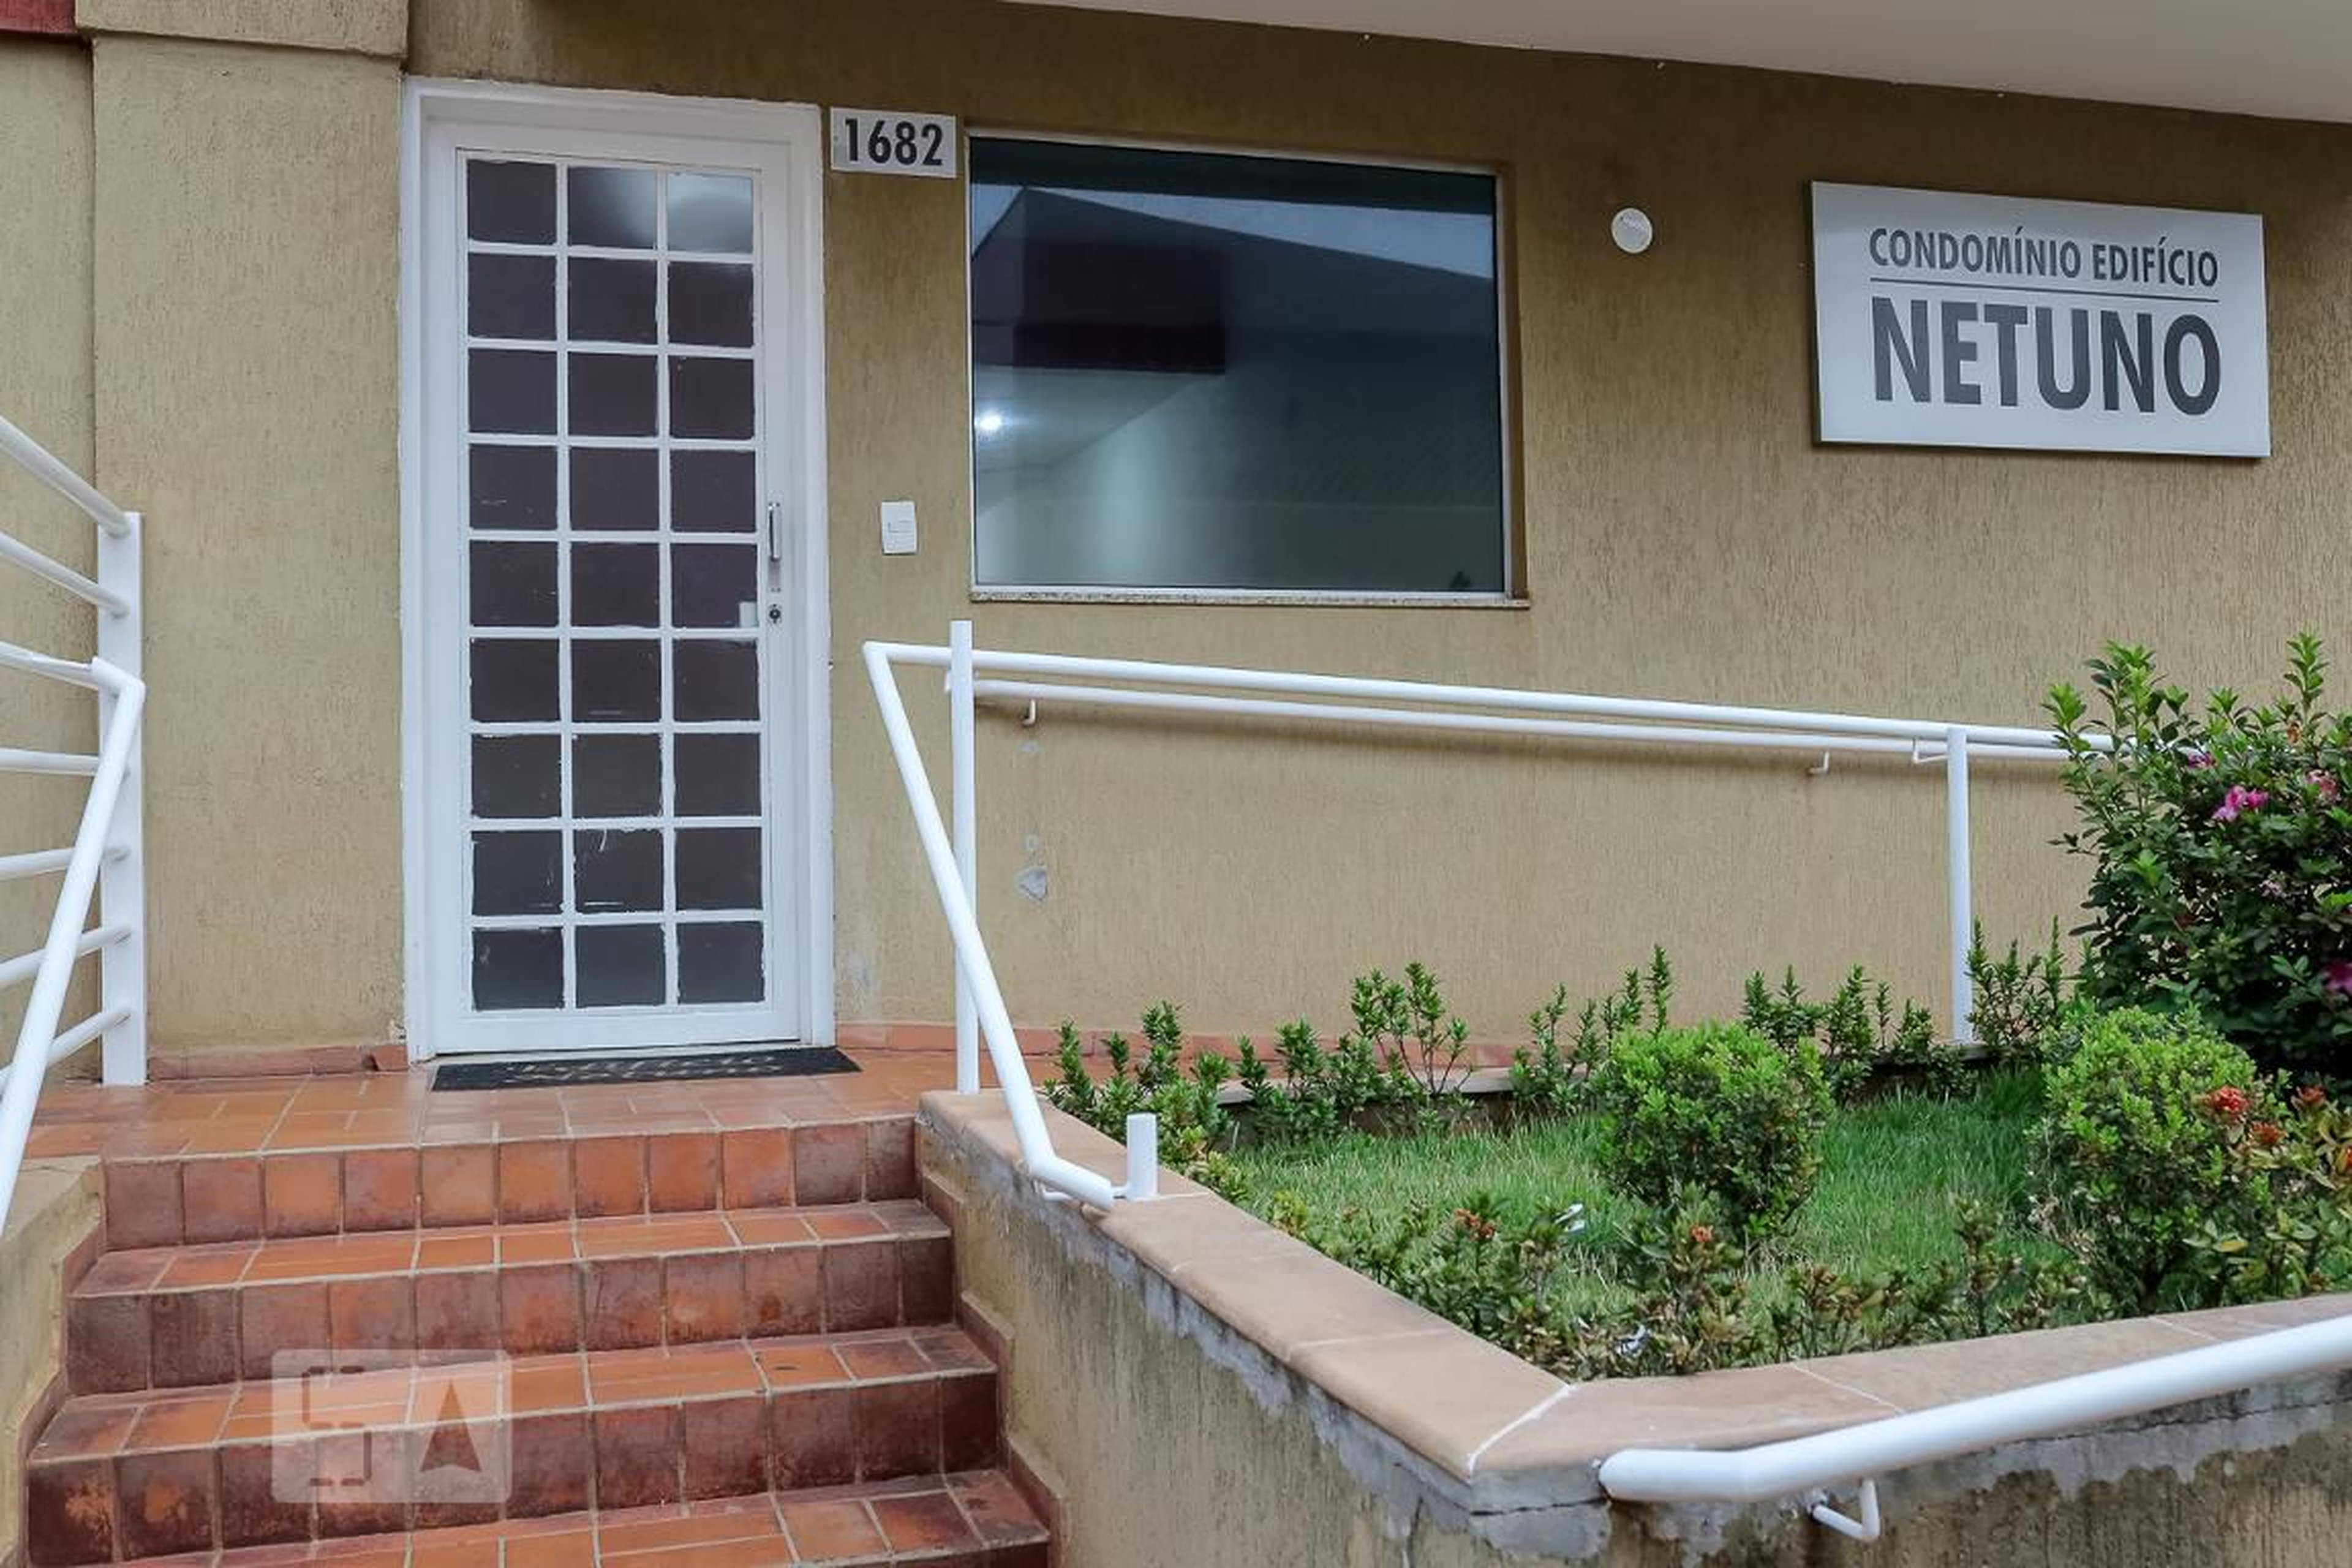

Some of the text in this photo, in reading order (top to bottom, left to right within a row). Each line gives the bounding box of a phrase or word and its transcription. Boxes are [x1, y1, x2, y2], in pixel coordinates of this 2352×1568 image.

[845, 118, 943, 166] 1682
[1869, 226, 2219, 286] CONDOMÍNIO EDIFÍCIO
[1871, 296, 2222, 415] NETUNO
